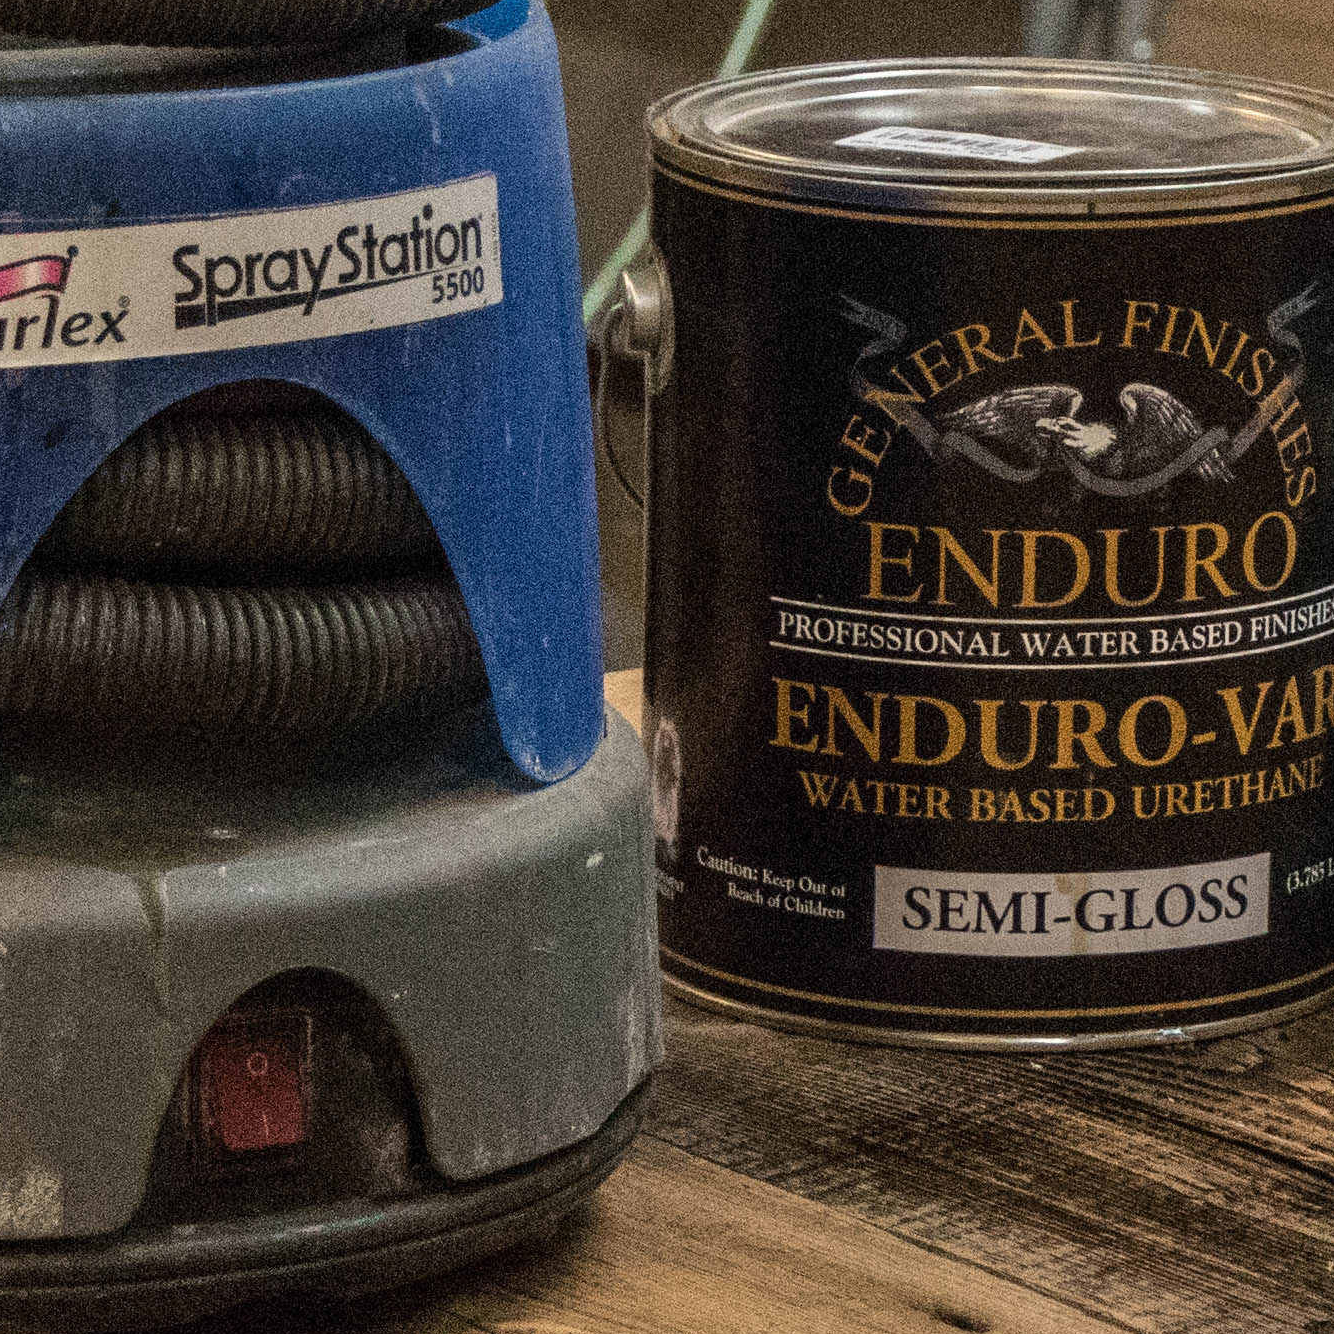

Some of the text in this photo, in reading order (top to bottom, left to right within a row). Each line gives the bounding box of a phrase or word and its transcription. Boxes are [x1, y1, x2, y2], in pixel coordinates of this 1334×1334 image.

[172, 204, 483, 323] SprayStation
[431, 266, 485, 304] 5500
[827, 300, 1318, 517] GENERAL FINISHES
[862, 512, 1297, 609] ENDURO
[778, 611, 1009, 657] PROFESSIONAL
[1020, 627, 1138, 658] WATER
[1149, 620, 1242, 655] BASED
[799, 756, 1323, 823] WATER BASED URETHANE
[696, 845, 846, 897] Caution: Keep Out of
[728, 882, 845, 920] Reach of Children
[902, 876, 1248, 936] SEMI-GLOSS
